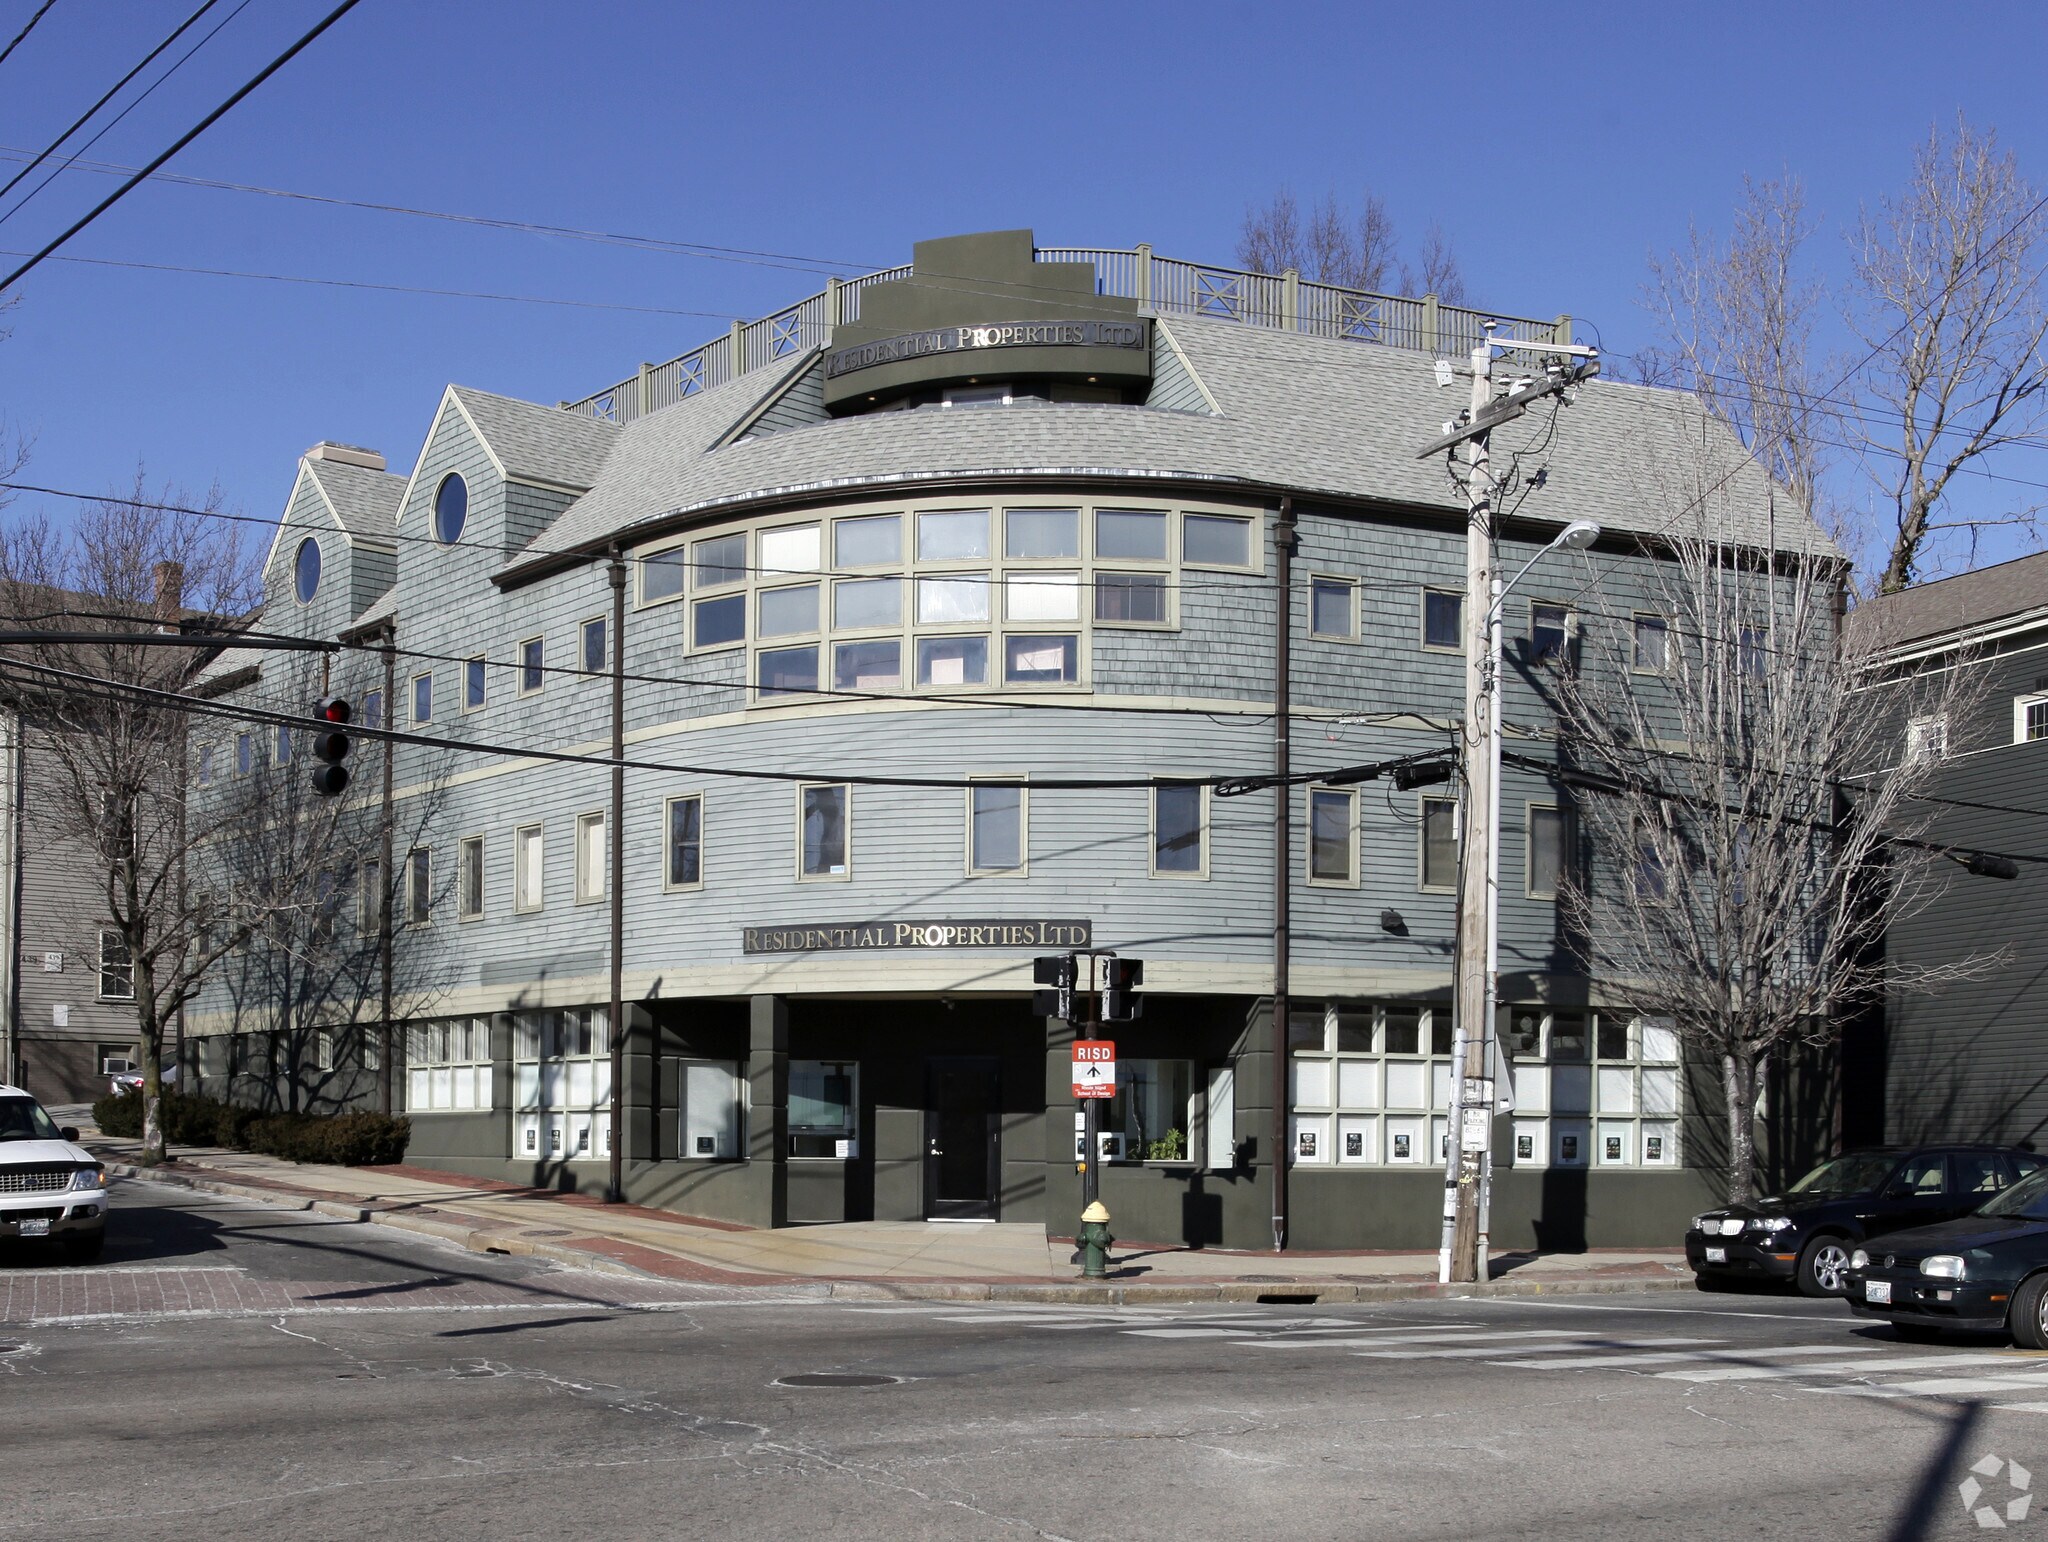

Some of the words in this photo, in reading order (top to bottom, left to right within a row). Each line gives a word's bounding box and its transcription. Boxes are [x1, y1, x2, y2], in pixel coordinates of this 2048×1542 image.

[828, 334, 947, 377] RESIDENTIAL
[956, 324, 1085, 349] PROPERTIES
[1094, 323, 1138, 346] LTD
[748, 927, 889, 952] RESIDENTIAL
[893, 922, 1036, 949] PROPERTIES
[1037, 921, 1088, 947] LTD
[1078, 1047, 1110, 1060] RISD
